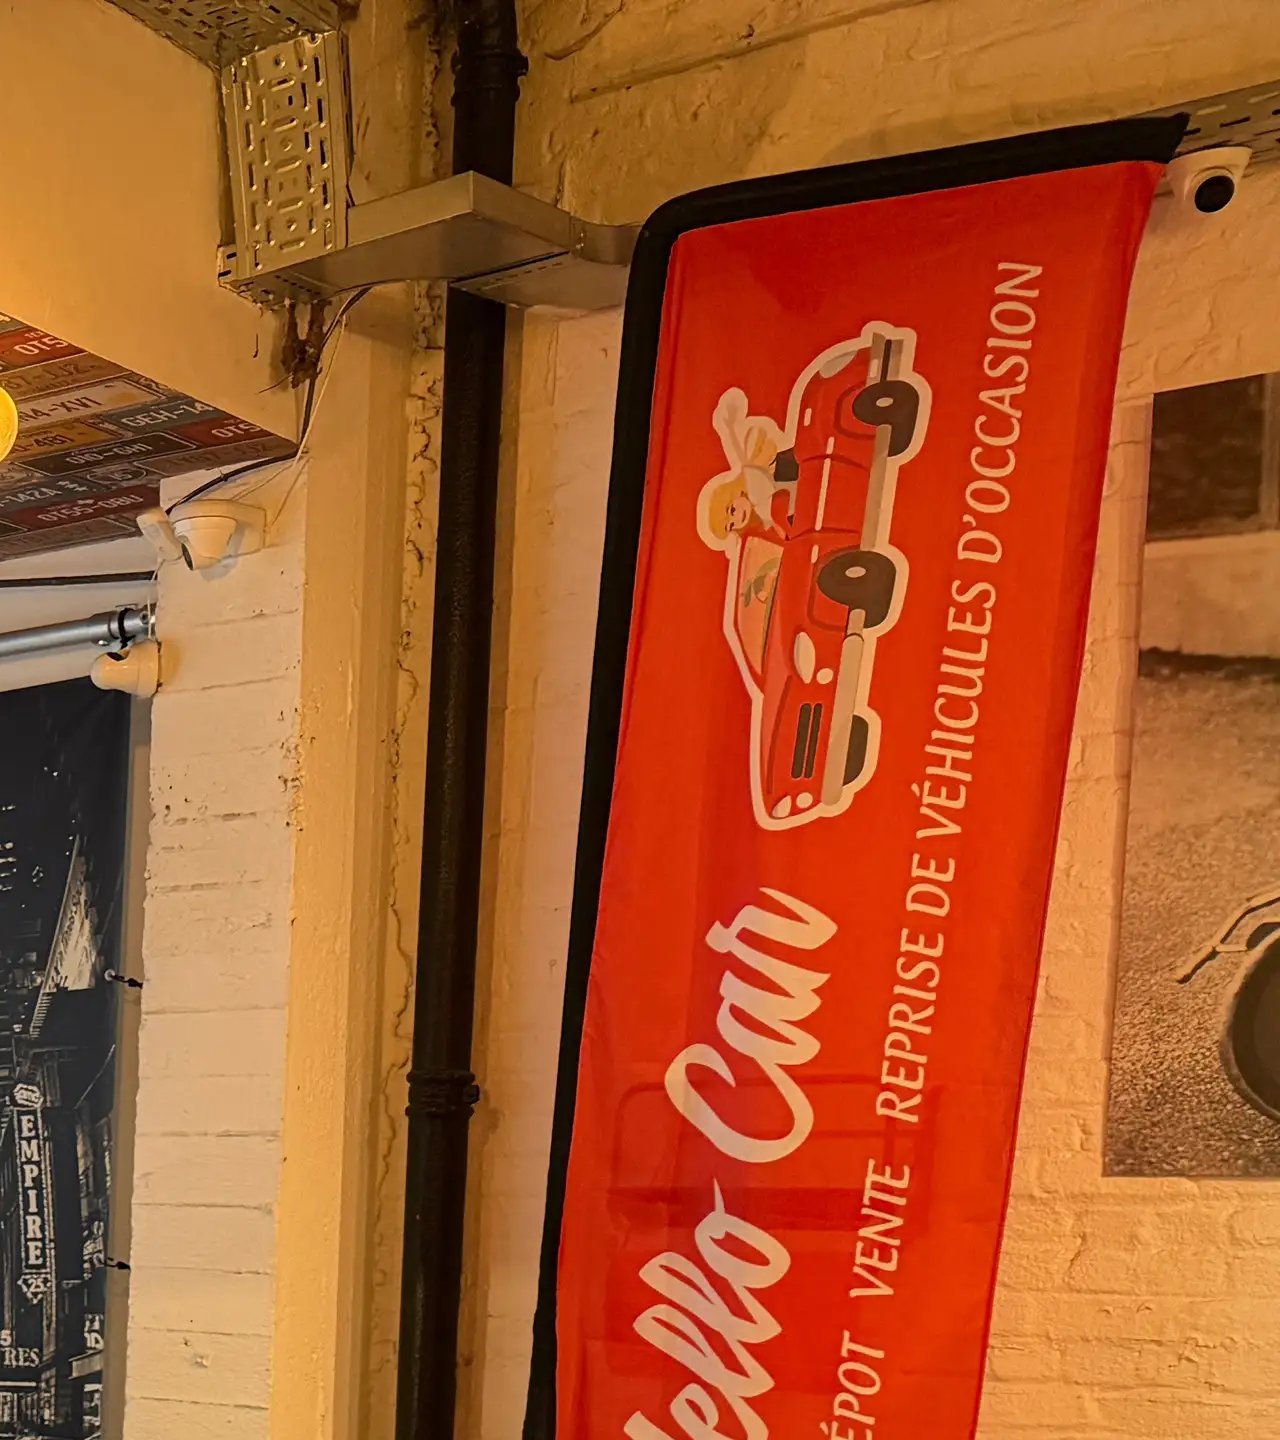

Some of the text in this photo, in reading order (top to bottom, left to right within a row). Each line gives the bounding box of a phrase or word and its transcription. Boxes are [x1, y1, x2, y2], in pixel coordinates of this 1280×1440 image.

[960, 261, 1043, 564] D'OCCASION
[909, 577, 997, 843] VÉHICULES
[906, 852, 956, 919] DE
[664, 886, 838, 1164] Car
[876, 931, 945, 1124] REPRISE
[20, 1114, 46, 1266] EMPIRE
[850, 1159, 912, 1300] VENTE
